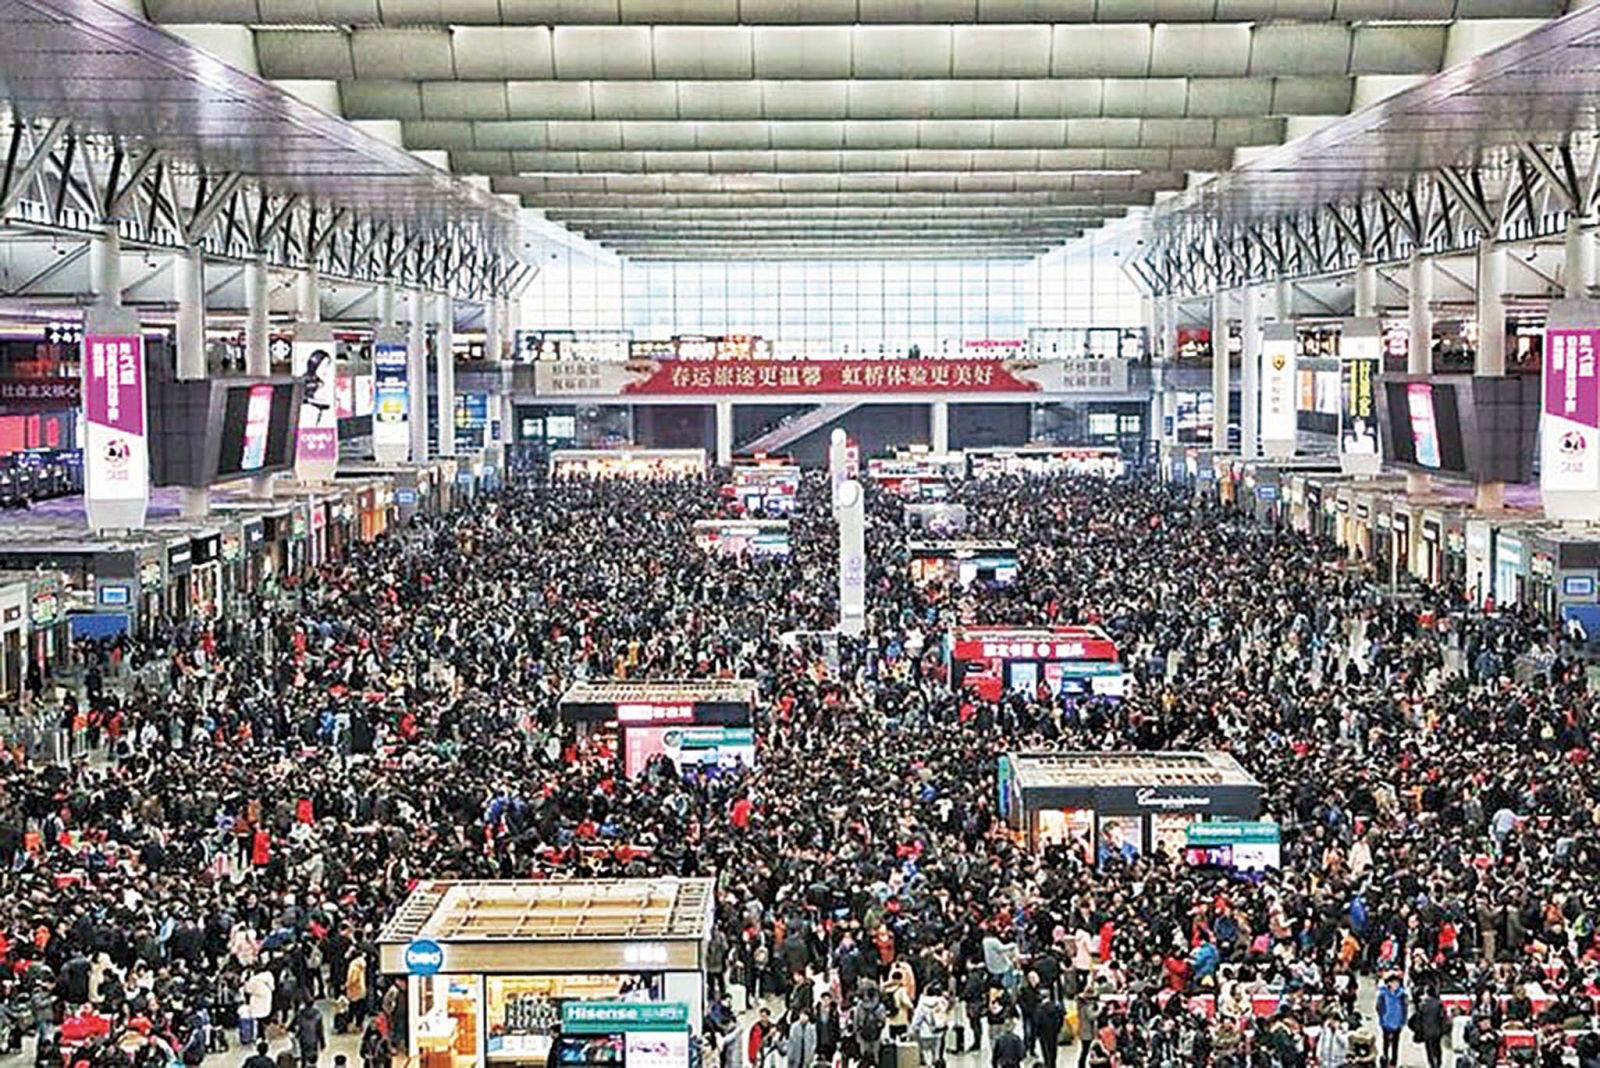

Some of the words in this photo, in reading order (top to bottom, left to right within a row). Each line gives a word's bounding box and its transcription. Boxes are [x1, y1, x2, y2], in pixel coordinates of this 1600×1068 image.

[671, 366, 822, 388] 春运旅途更温馨
[840, 365, 994, 387] 虹桥体验更美好
[567, 1006, 638, 1021] Hisense
